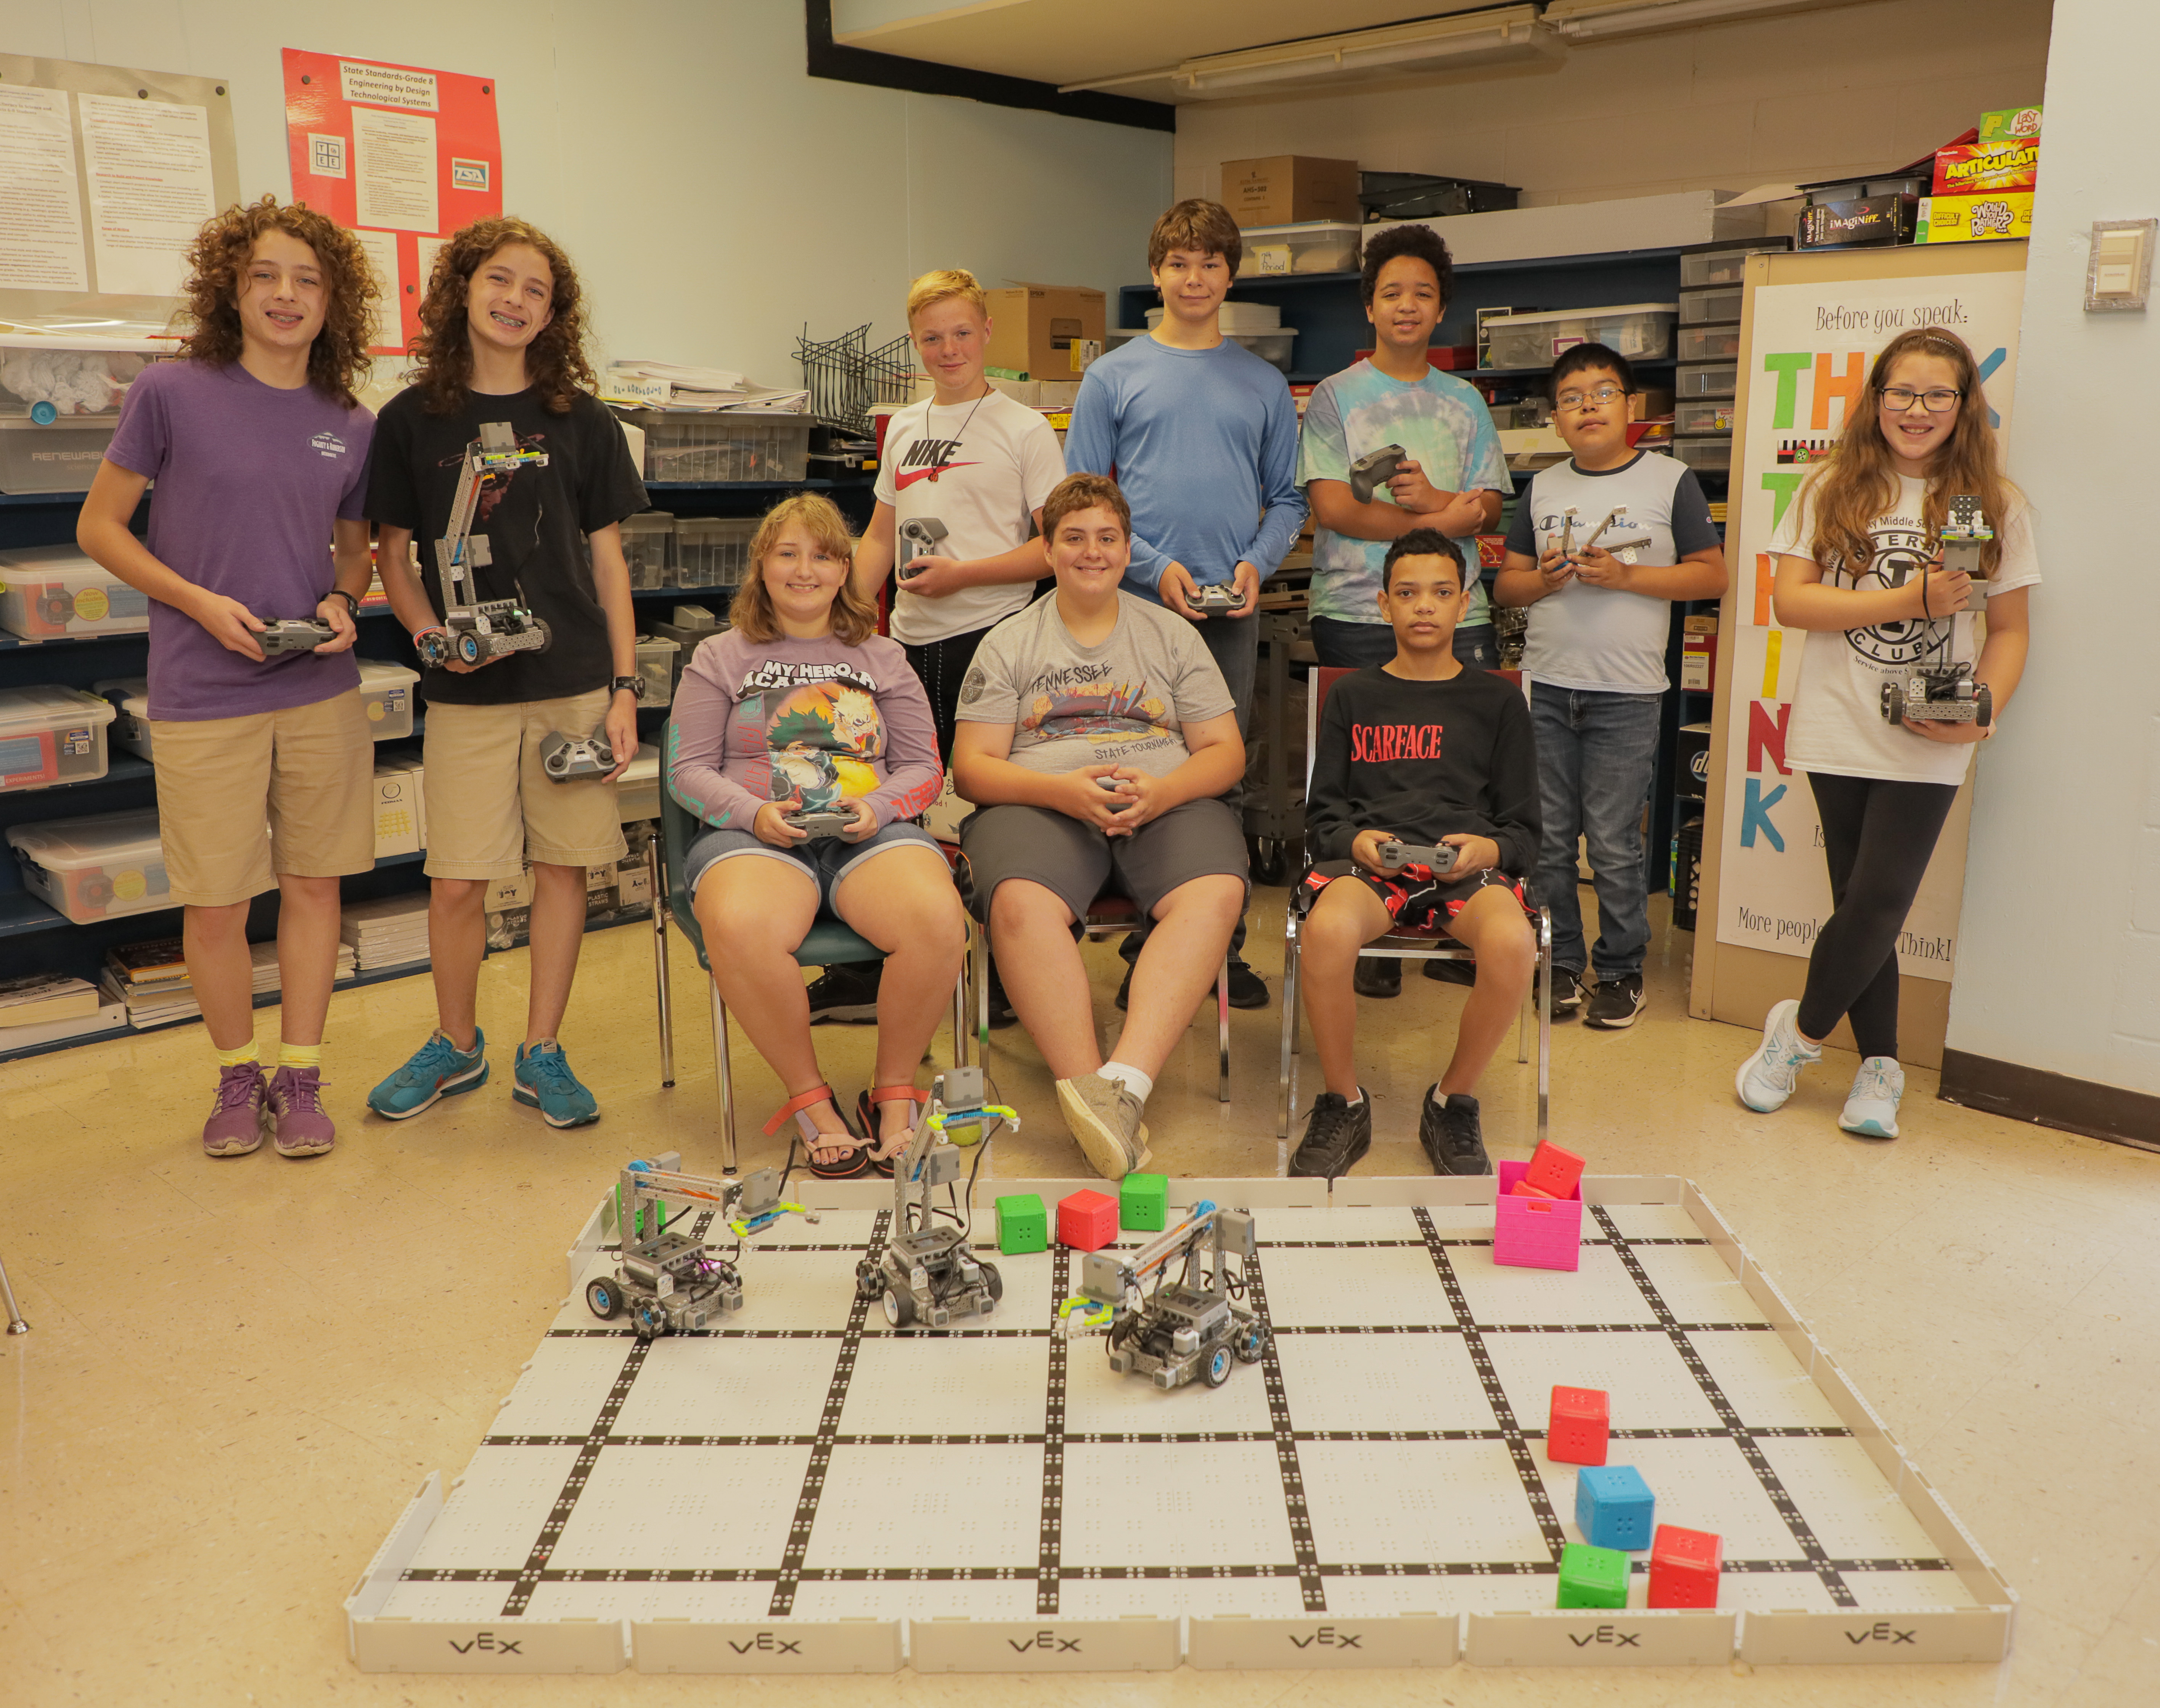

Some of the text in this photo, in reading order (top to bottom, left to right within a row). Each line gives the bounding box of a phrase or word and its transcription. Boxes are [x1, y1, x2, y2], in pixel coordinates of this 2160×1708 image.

[344, 66, 363, 75] State
[365, 69, 427, 84] Standards-Grade
[349, 79, 430, 97] Engineering by Design
[351, 90, 431, 107] Technological Systems
[1933, 212, 1960, 220] DIFFICULT
[1971, 201, 2008, 218] WOULD
[1986, 211, 1998, 220] YOU
[1261, 260, 1285, 271] Period
[1816, 299, 1968, 334] Before you speak:
[901, 439, 963, 467] NIKE
[1879, 516, 1914, 527] Middle
[1854, 632, 1922, 660] CLUB
[762, 660, 853, 679] MY HERO
[1853, 655, 1879, 672] Service
[1031, 659, 1114, 694] TENNESSEE
[1351, 724, 1443, 762] SCARFACE
[1095, 745, 1131, 761] STATE
[5, 774, 45, 783] EXPERIMENTS!
[588, 893, 609, 902] PLASTIC
[588, 898, 609, 907] STRAWS
[1738, 906, 1771, 933] More
[1899, 930, 1951, 962] Think!
[1008, 1629, 1083, 1653] VEX
[1288, 1626, 1363, 1649] VEX
[1568, 1625, 1641, 1649] VEX
[1845, 1622, 1917, 1645] VEX
[448, 1632, 524, 1655] VEX
[727, 1632, 803, 1655] VEX
